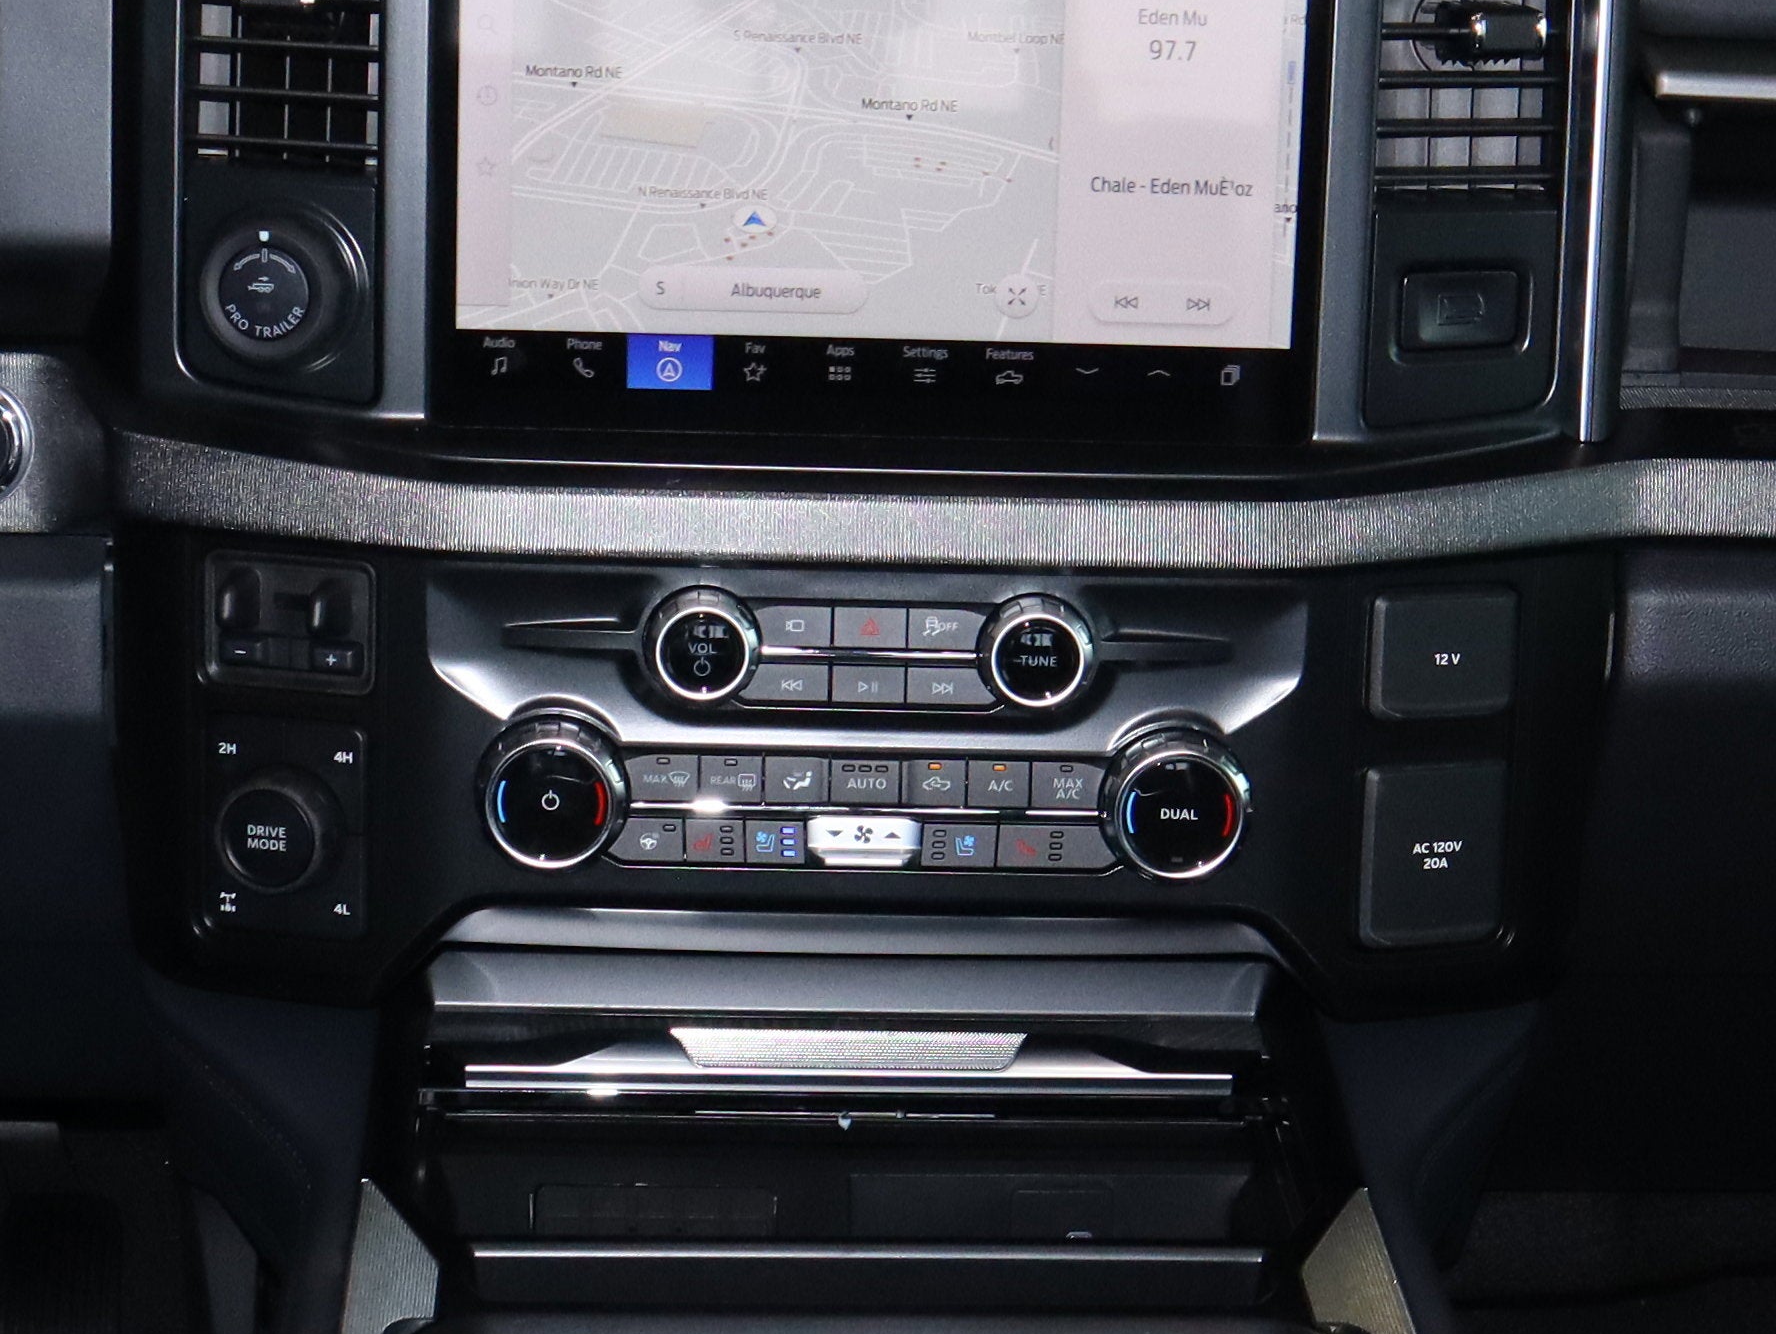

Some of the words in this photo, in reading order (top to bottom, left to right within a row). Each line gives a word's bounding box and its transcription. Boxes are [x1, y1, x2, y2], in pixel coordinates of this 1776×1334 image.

[1138, 9, 1180, 26] Eden
[1183, 10, 1208, 27] Mu
[743, 30, 815, 43] Renaissance
[846, 33, 863, 45] NE
[1149, 40, 1197, 62] 97.7
[525, 64, 582, 79] Montano
[584, 65, 603, 79] Rd
[605, 66, 623, 80] NE
[861, 97, 919, 112] Montano
[921, 98, 938, 113] Rd
[940, 99, 958, 113] NE
[1091, 176, 1136, 195] Chale
[1151, 178, 1190, 196] Eden
[637, 186, 647, 198] N
[648, 186, 721, 200] Renaissance
[722, 187, 748, 200] Blvd
[751, 188, 768, 201] NE
[583, 279, 599, 291] NE
[655, 281, 666, 296] S
[731, 282, 822, 301] Albuquerque
[225, 303, 249, 330] PRO
[254, 306, 305, 338] TRAILER
[482, 336, 516, 350] Audio
[566, 338, 603, 351] Phone
[658, 340, 682, 353] Nav
[744, 342, 766, 354] Fav
[826, 344, 855, 357] Apps
[902, 346, 949, 361] Settings
[985, 347, 1035, 362] Features
[937, 621, 959, 633] OFF
[688, 643, 717, 655] VOL
[1020, 654, 1058, 668] TUNE
[1433, 653, 1449, 666] 12
[1450, 653, 1461, 666] V
[217, 742, 237, 755] 2H
[333, 751, 353, 765] 4H
[643, 774, 669, 784] MAX
[710, 775, 736, 786] REAR
[846, 778, 887, 790] AUTO
[987, 779, 1014, 793] A/C
[1052, 777, 1084, 789] MAX
[1055, 788, 1081, 801] A/C
[1160, 808, 1199, 822] DUAL
[246, 824, 287, 839] DRIVE
[246, 837, 287, 852] MODE
[1412, 842, 1430, 855] AC
[1432, 840, 1463, 854] 120V
[1422, 856, 1449, 870] 20A
[333, 903, 351, 916] 4L
